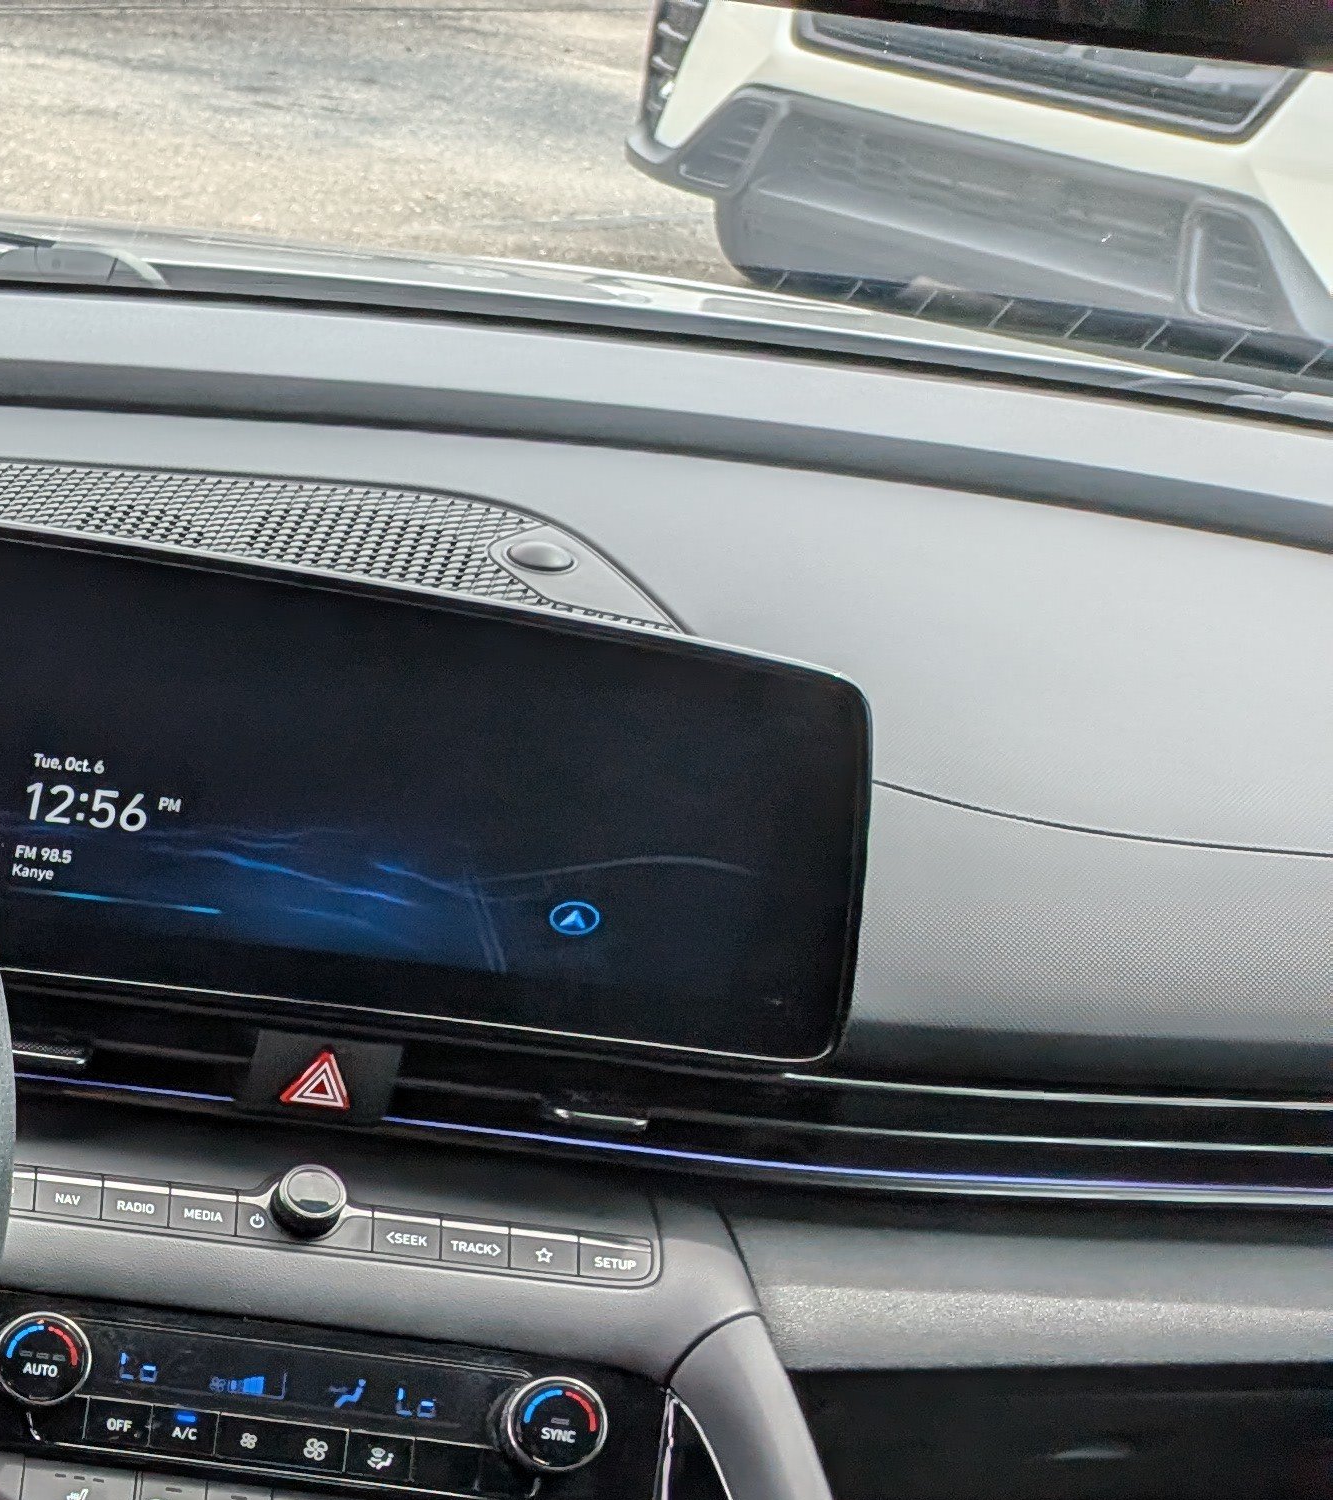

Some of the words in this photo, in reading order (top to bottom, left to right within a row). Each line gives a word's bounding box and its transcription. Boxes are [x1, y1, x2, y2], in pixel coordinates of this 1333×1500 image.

[33, 752, 63, 771] Tue.
[64, 756, 92, 773] Oct.
[93, 759, 106, 775] 6
[26, 781, 148, 832] 12:56
[157, 796, 182, 813] PM
[14, 844, 37, 861] FM
[40, 847, 73, 864] 98.5
[11, 863, 55, 882] Kanye
[54, 1192, 81, 1206] NAV
[116, 1199, 156, 1215] RADIO
[183, 1207, 224, 1223] MEDIA
[594, 1256, 637, 1272] SETUP
[22, 1361, 59, 1379] AUTO
[106, 1417, 133, 1433] OFF
[171, 1426, 199, 1441] A/C
[540, 1426, 578, 1445] SYNC
